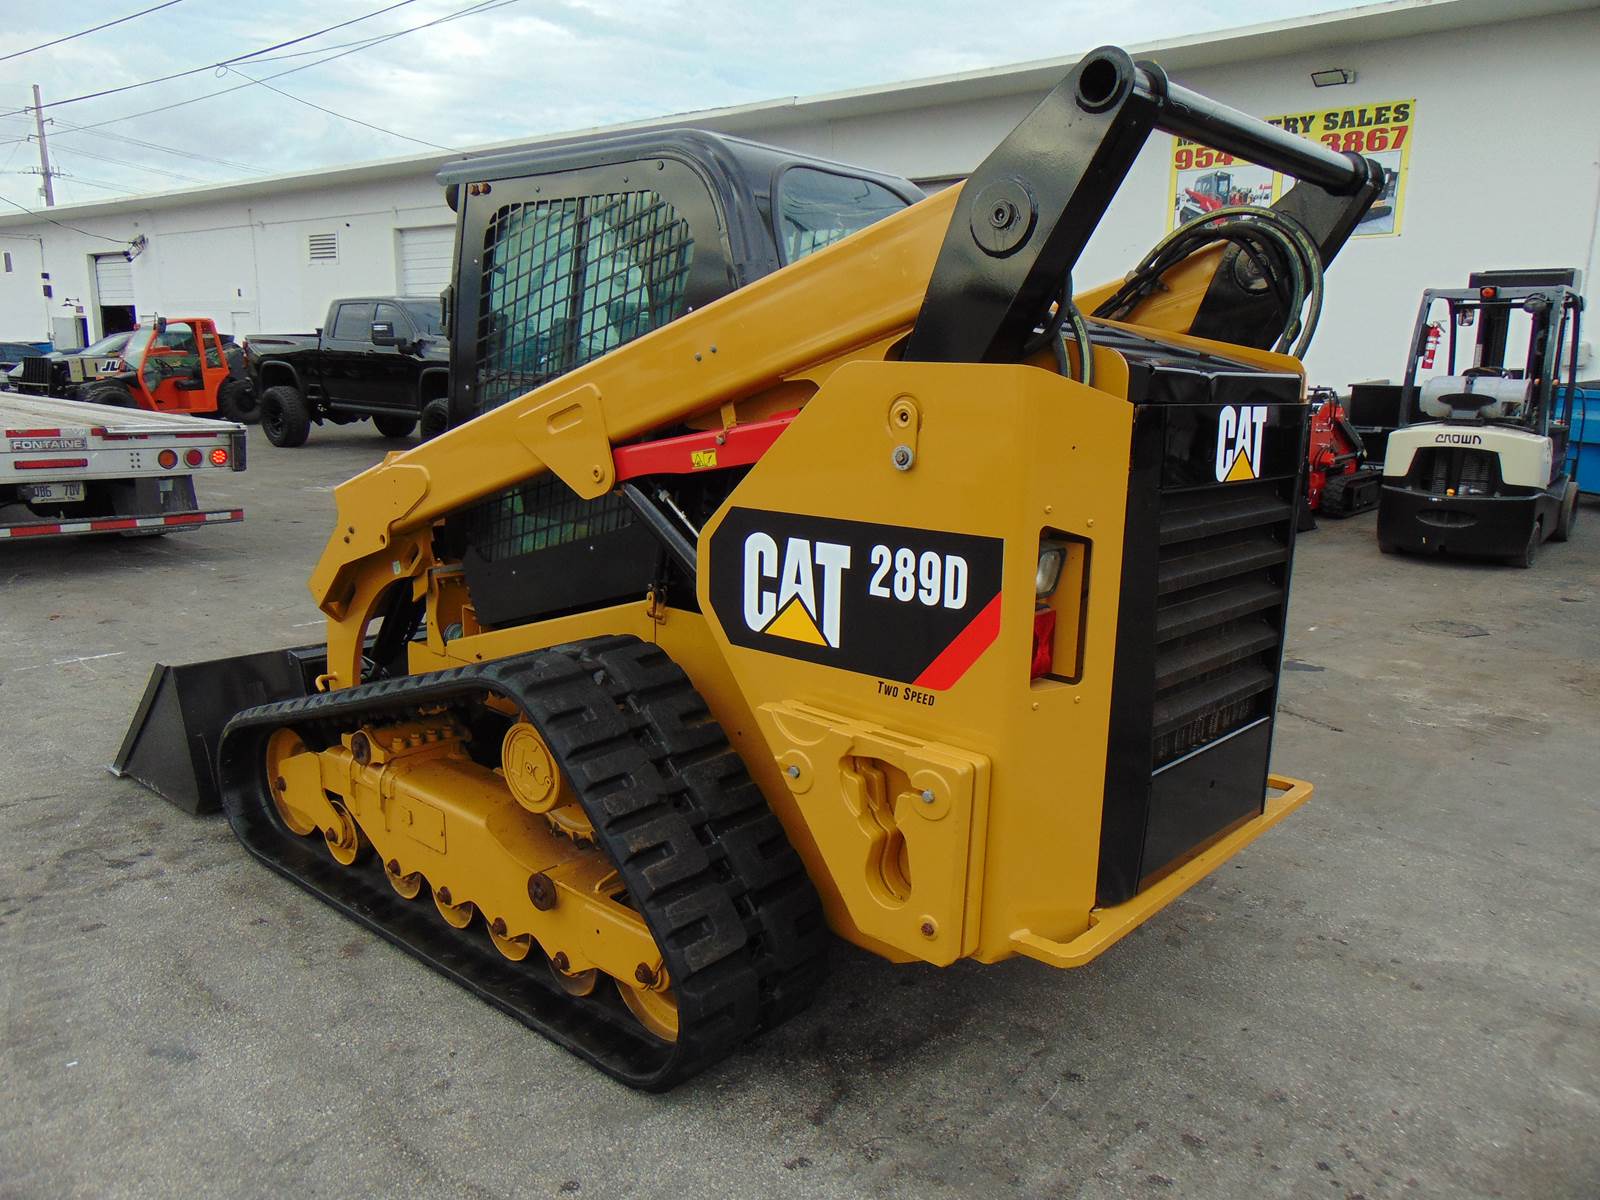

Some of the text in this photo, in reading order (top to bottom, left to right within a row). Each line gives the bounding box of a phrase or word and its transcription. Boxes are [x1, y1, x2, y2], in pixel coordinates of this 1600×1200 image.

[1323, 103, 1410, 131] SALES
[1175, 126, 1409, 170] 954 3867
[13, 440, 82, 450] FONTAINE
[1216, 405, 1267, 482] CAT
[1435, 433, 1482, 444] CROWN
[744, 532, 968, 648] CAT 289D
